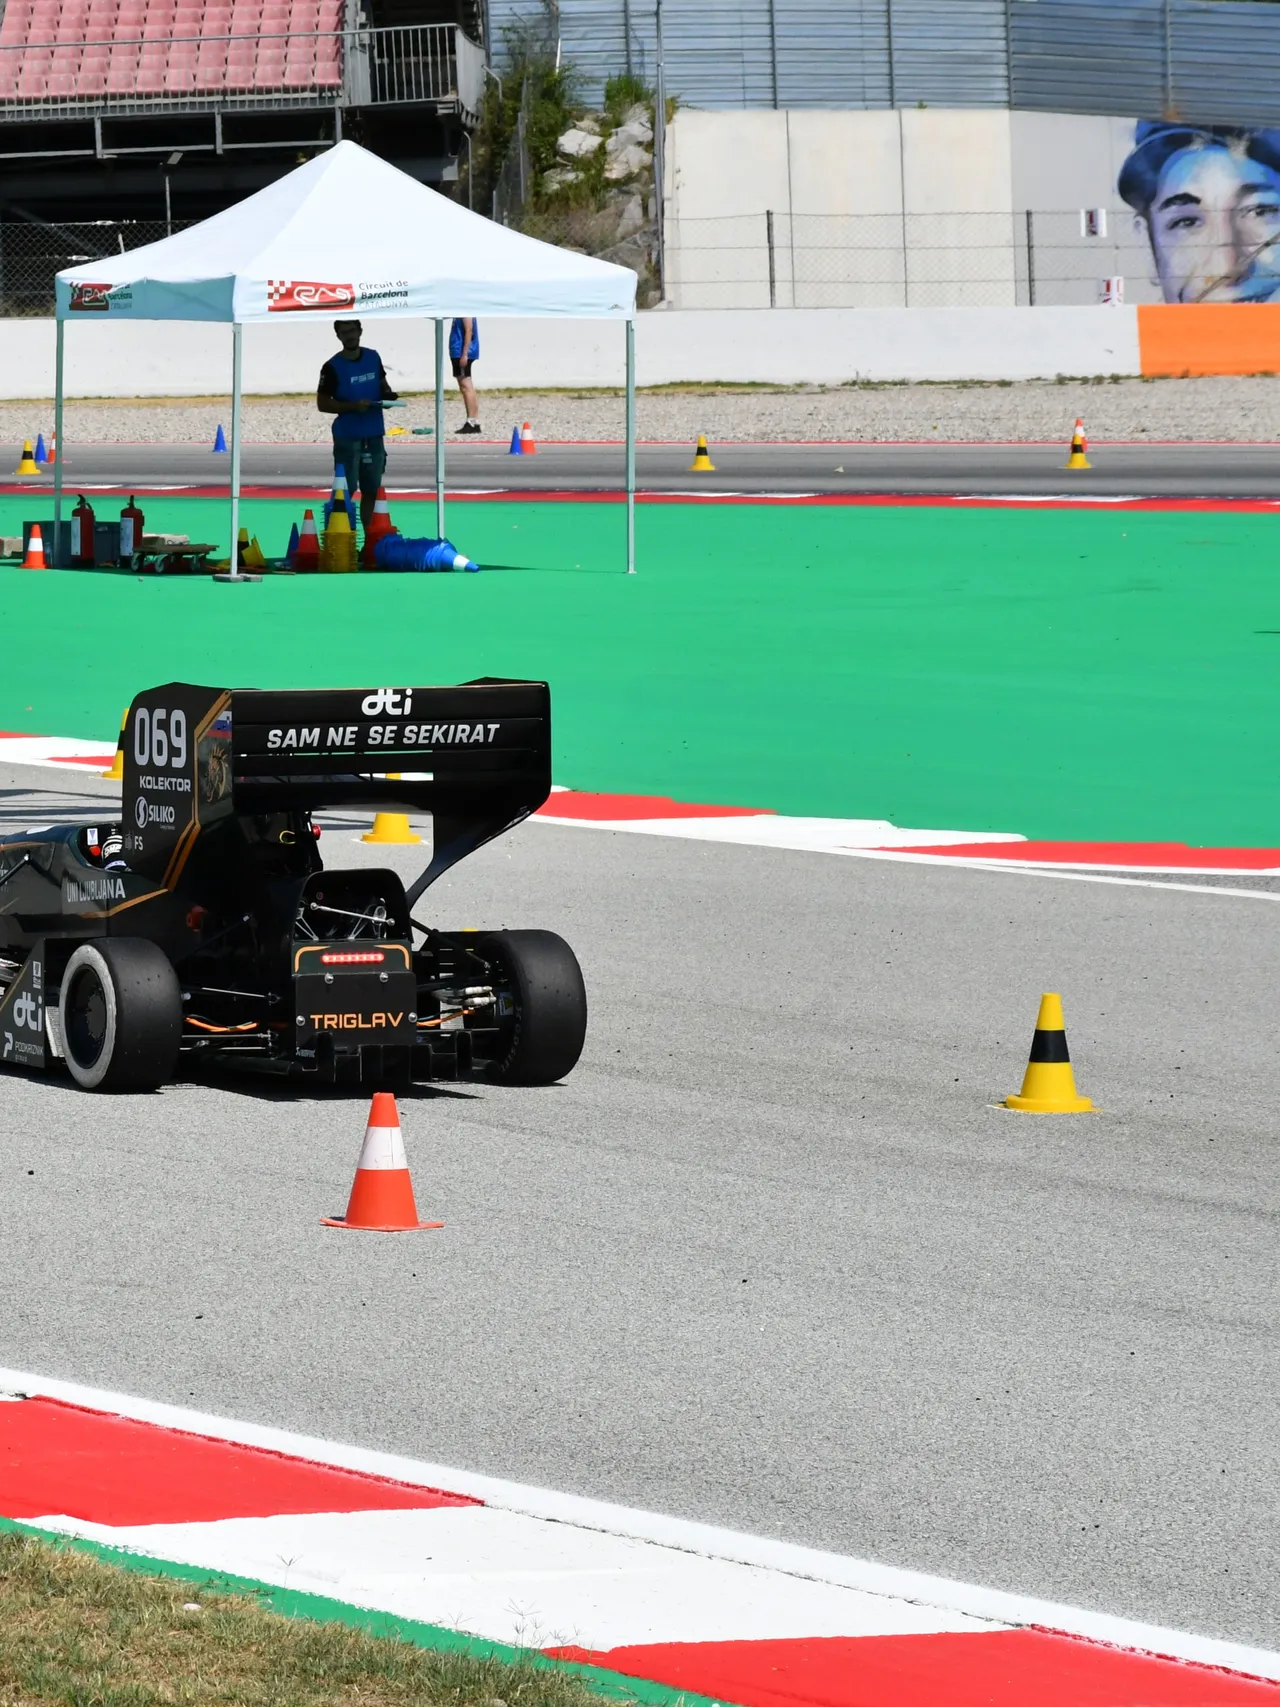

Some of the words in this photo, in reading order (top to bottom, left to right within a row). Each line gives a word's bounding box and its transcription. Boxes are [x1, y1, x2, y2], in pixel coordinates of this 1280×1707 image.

[358, 281, 395, 291] Circuit
[399, 279, 409, 287] de
[361, 289, 409, 300] Barcelona
[361, 688, 413, 716] dti
[134, 707, 187, 769] 069
[266, 728, 321, 749] SAM
[326, 727, 358, 746] NE
[367, 726, 397, 745] SE
[402, 724, 500, 744] SEKIRAT
[139, 775, 192, 792] KOLEKTOR
[148, 804, 175, 823] SILIKO
[66, 882, 79, 903] UNI
[80, 878, 126, 902] LJUBLJANA
[13, 991, 43, 1032] dti
[309, 1012, 404, 1029] TRIGLAV
